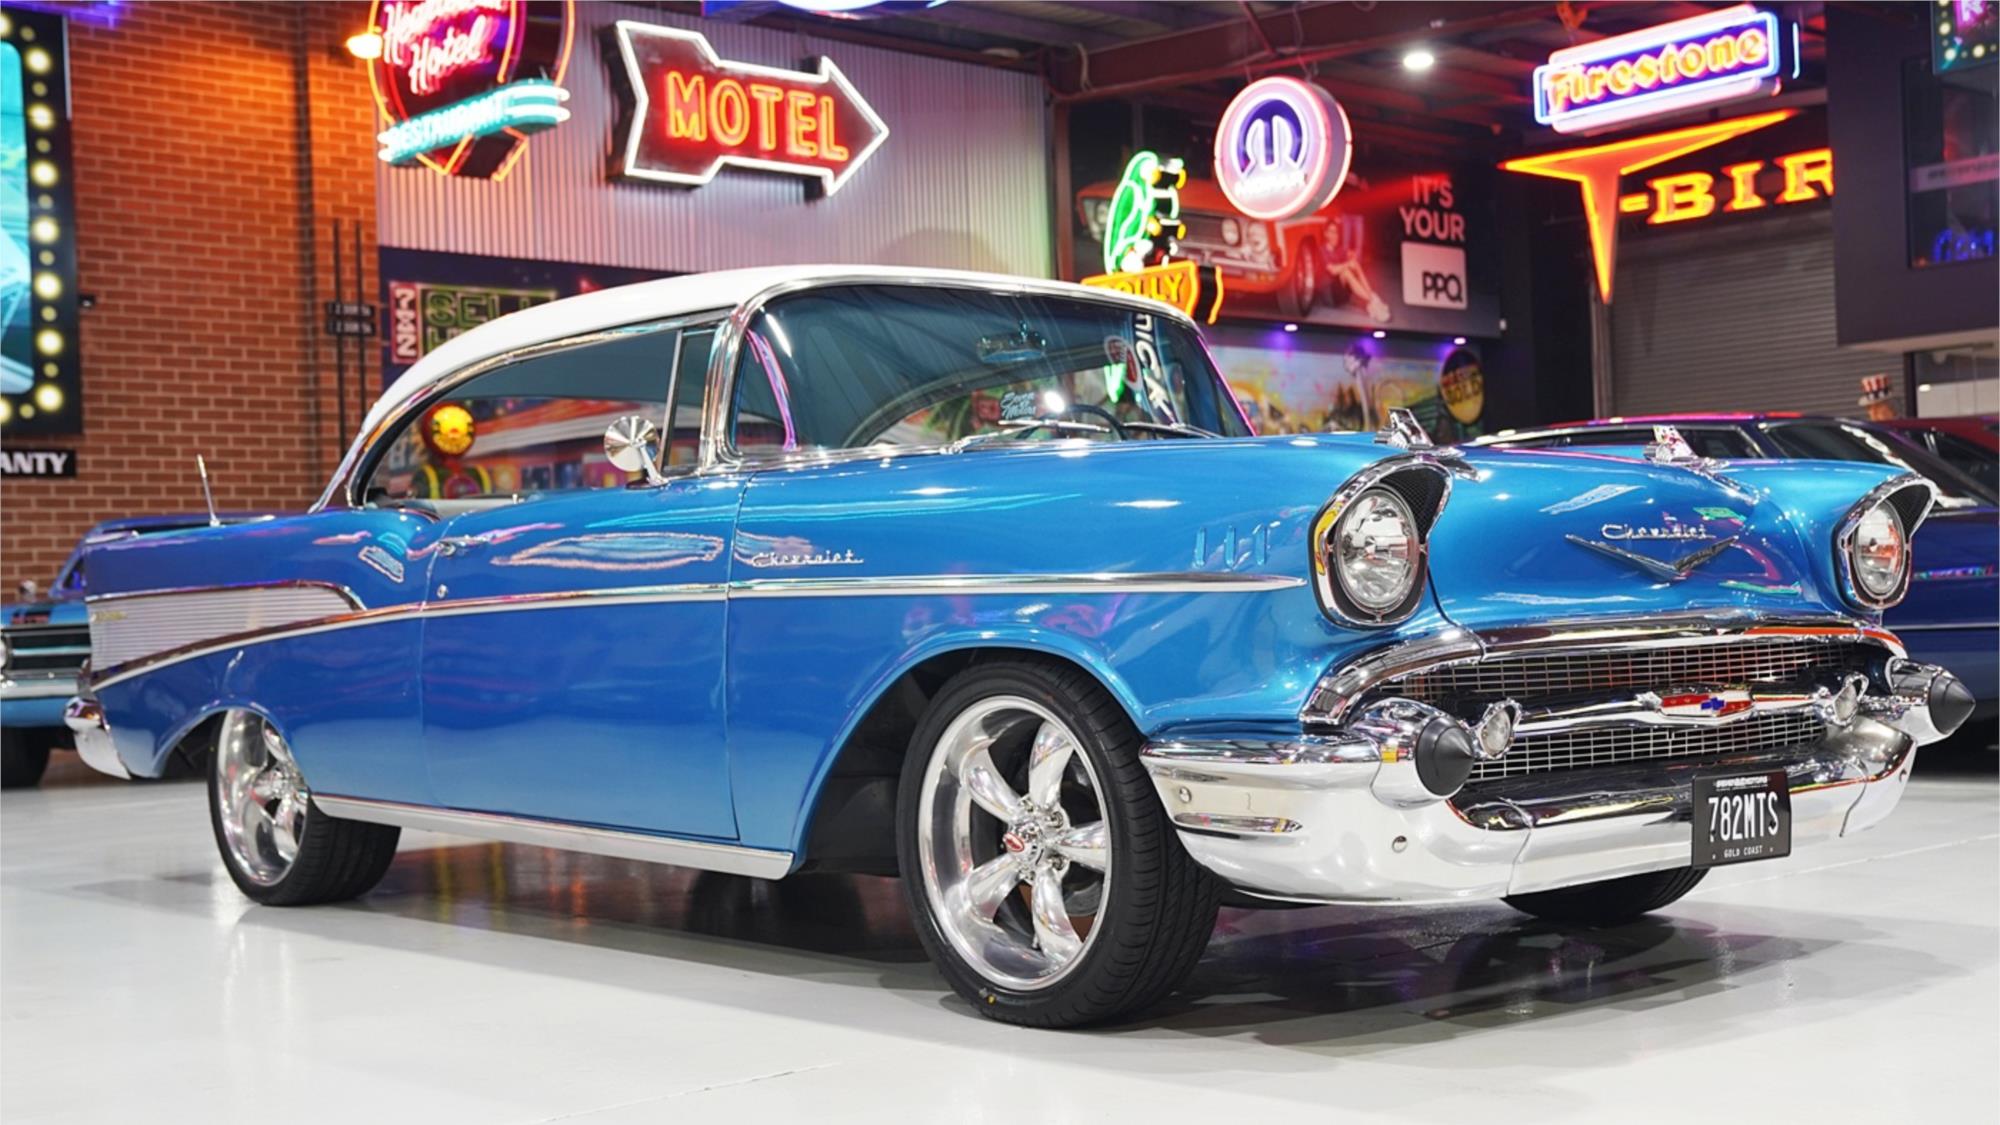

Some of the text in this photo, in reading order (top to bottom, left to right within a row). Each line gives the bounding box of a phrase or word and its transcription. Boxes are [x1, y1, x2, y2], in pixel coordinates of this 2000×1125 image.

[1545, 28, 1769, 111] Firestone
[666, 71, 848, 161] MOTEL
[1412, 175, 1454, 208] IT'S
[1400, 206, 1465, 241] YOUR
[1113, 273, 1183, 303] OLLY
[1422, 271, 1463, 303] PPQ
[1, 452, 68, 474] ANTY
[752, 549, 864, 569] Chevrolet
[1708, 790, 1779, 843] 782MTS
[1724, 847, 1741, 859] GOLD
